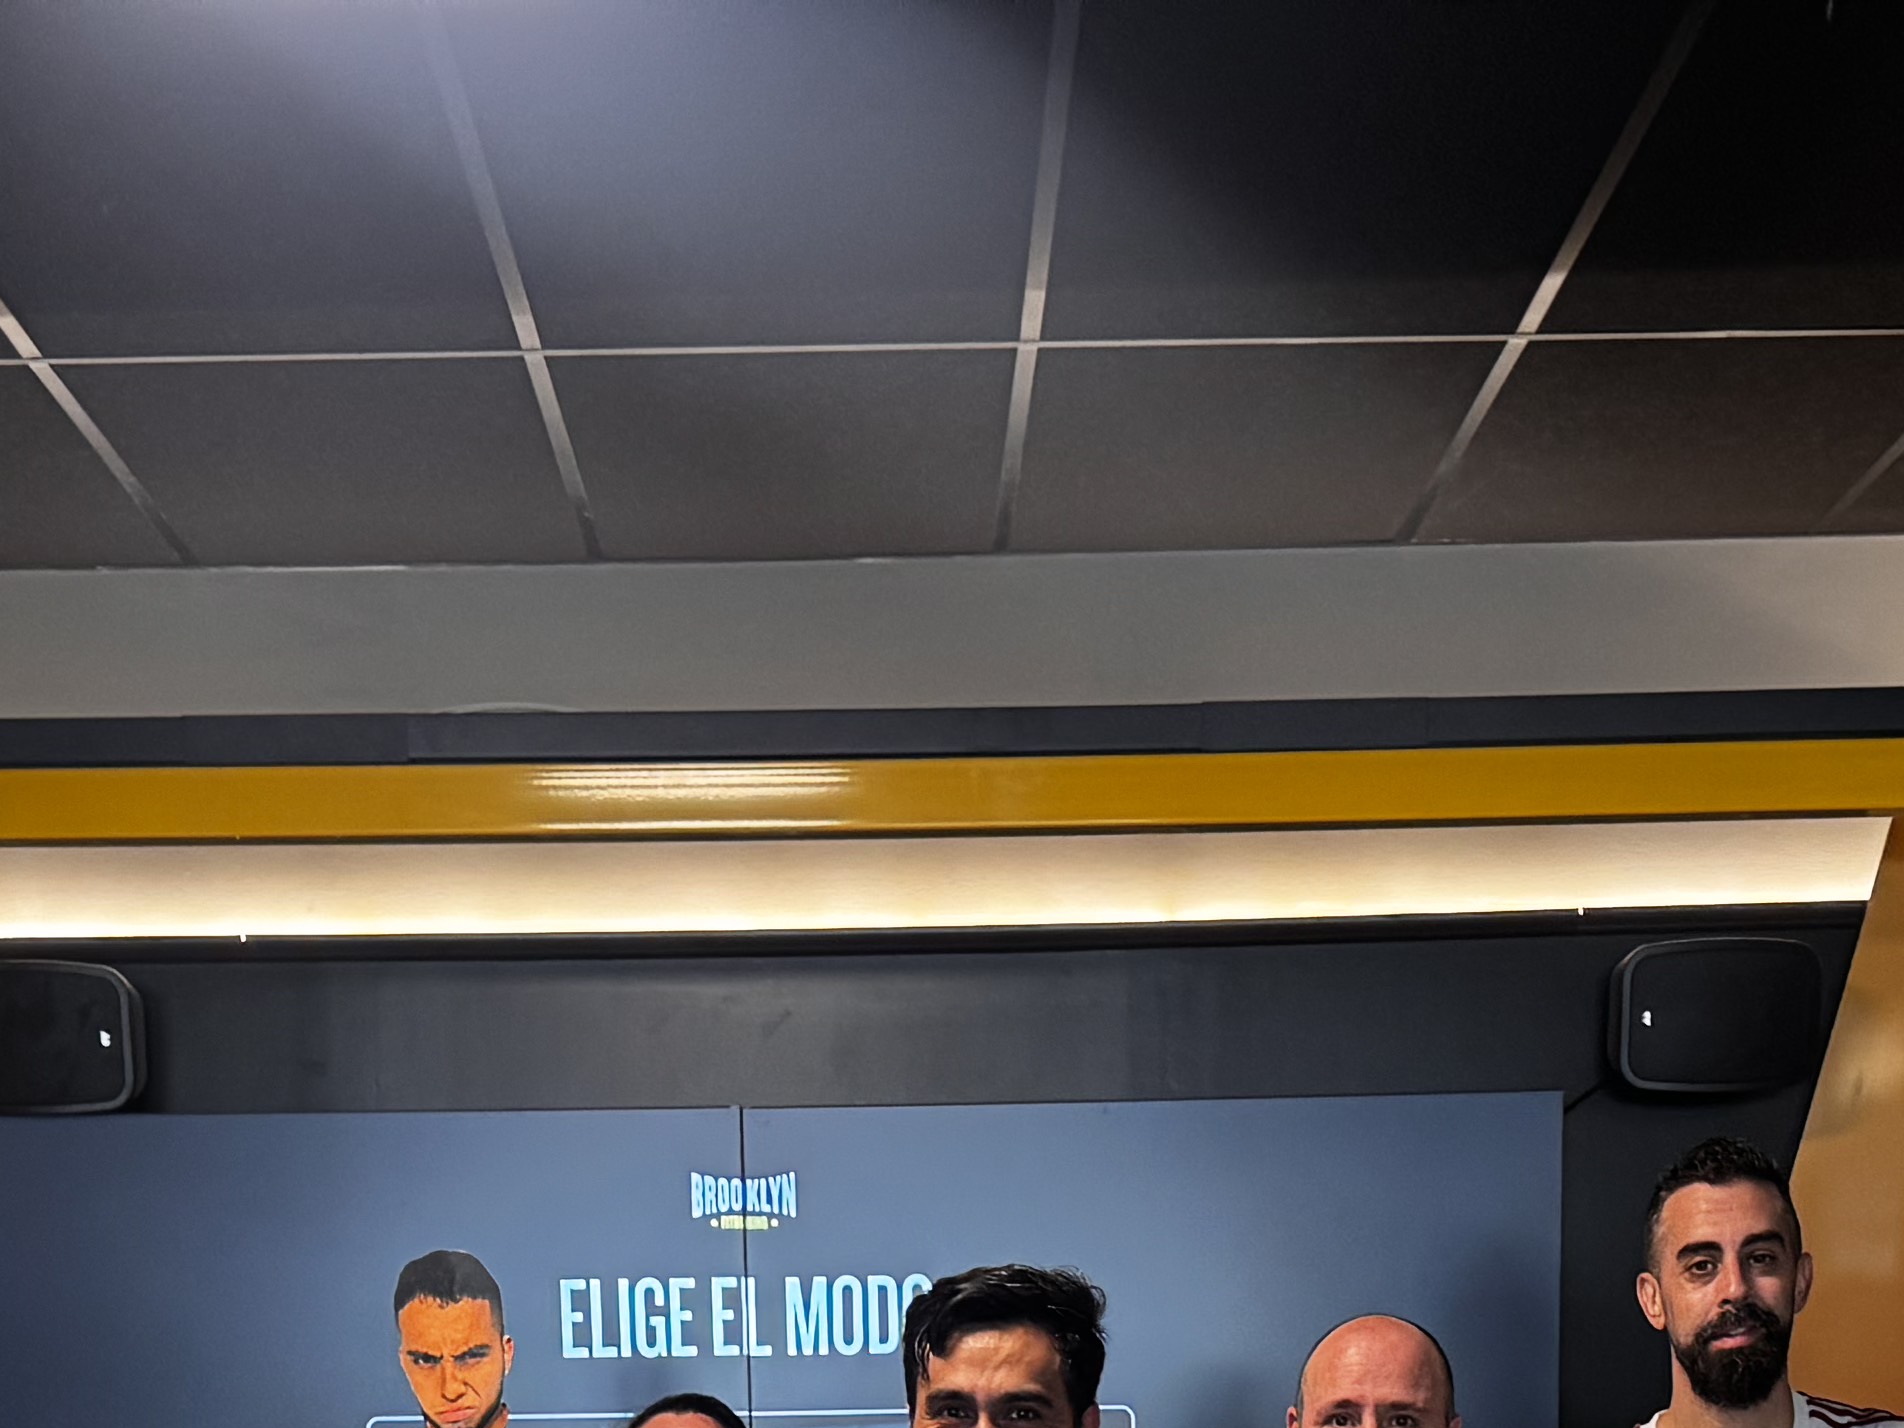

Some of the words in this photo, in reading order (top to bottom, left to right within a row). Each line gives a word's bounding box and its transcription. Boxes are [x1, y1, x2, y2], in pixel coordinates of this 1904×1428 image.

[690, 1171, 797, 1219] BROOKLYN
[559, 1277, 698, 1359] ELIGE
[710, 1276, 773, 1357] EL
